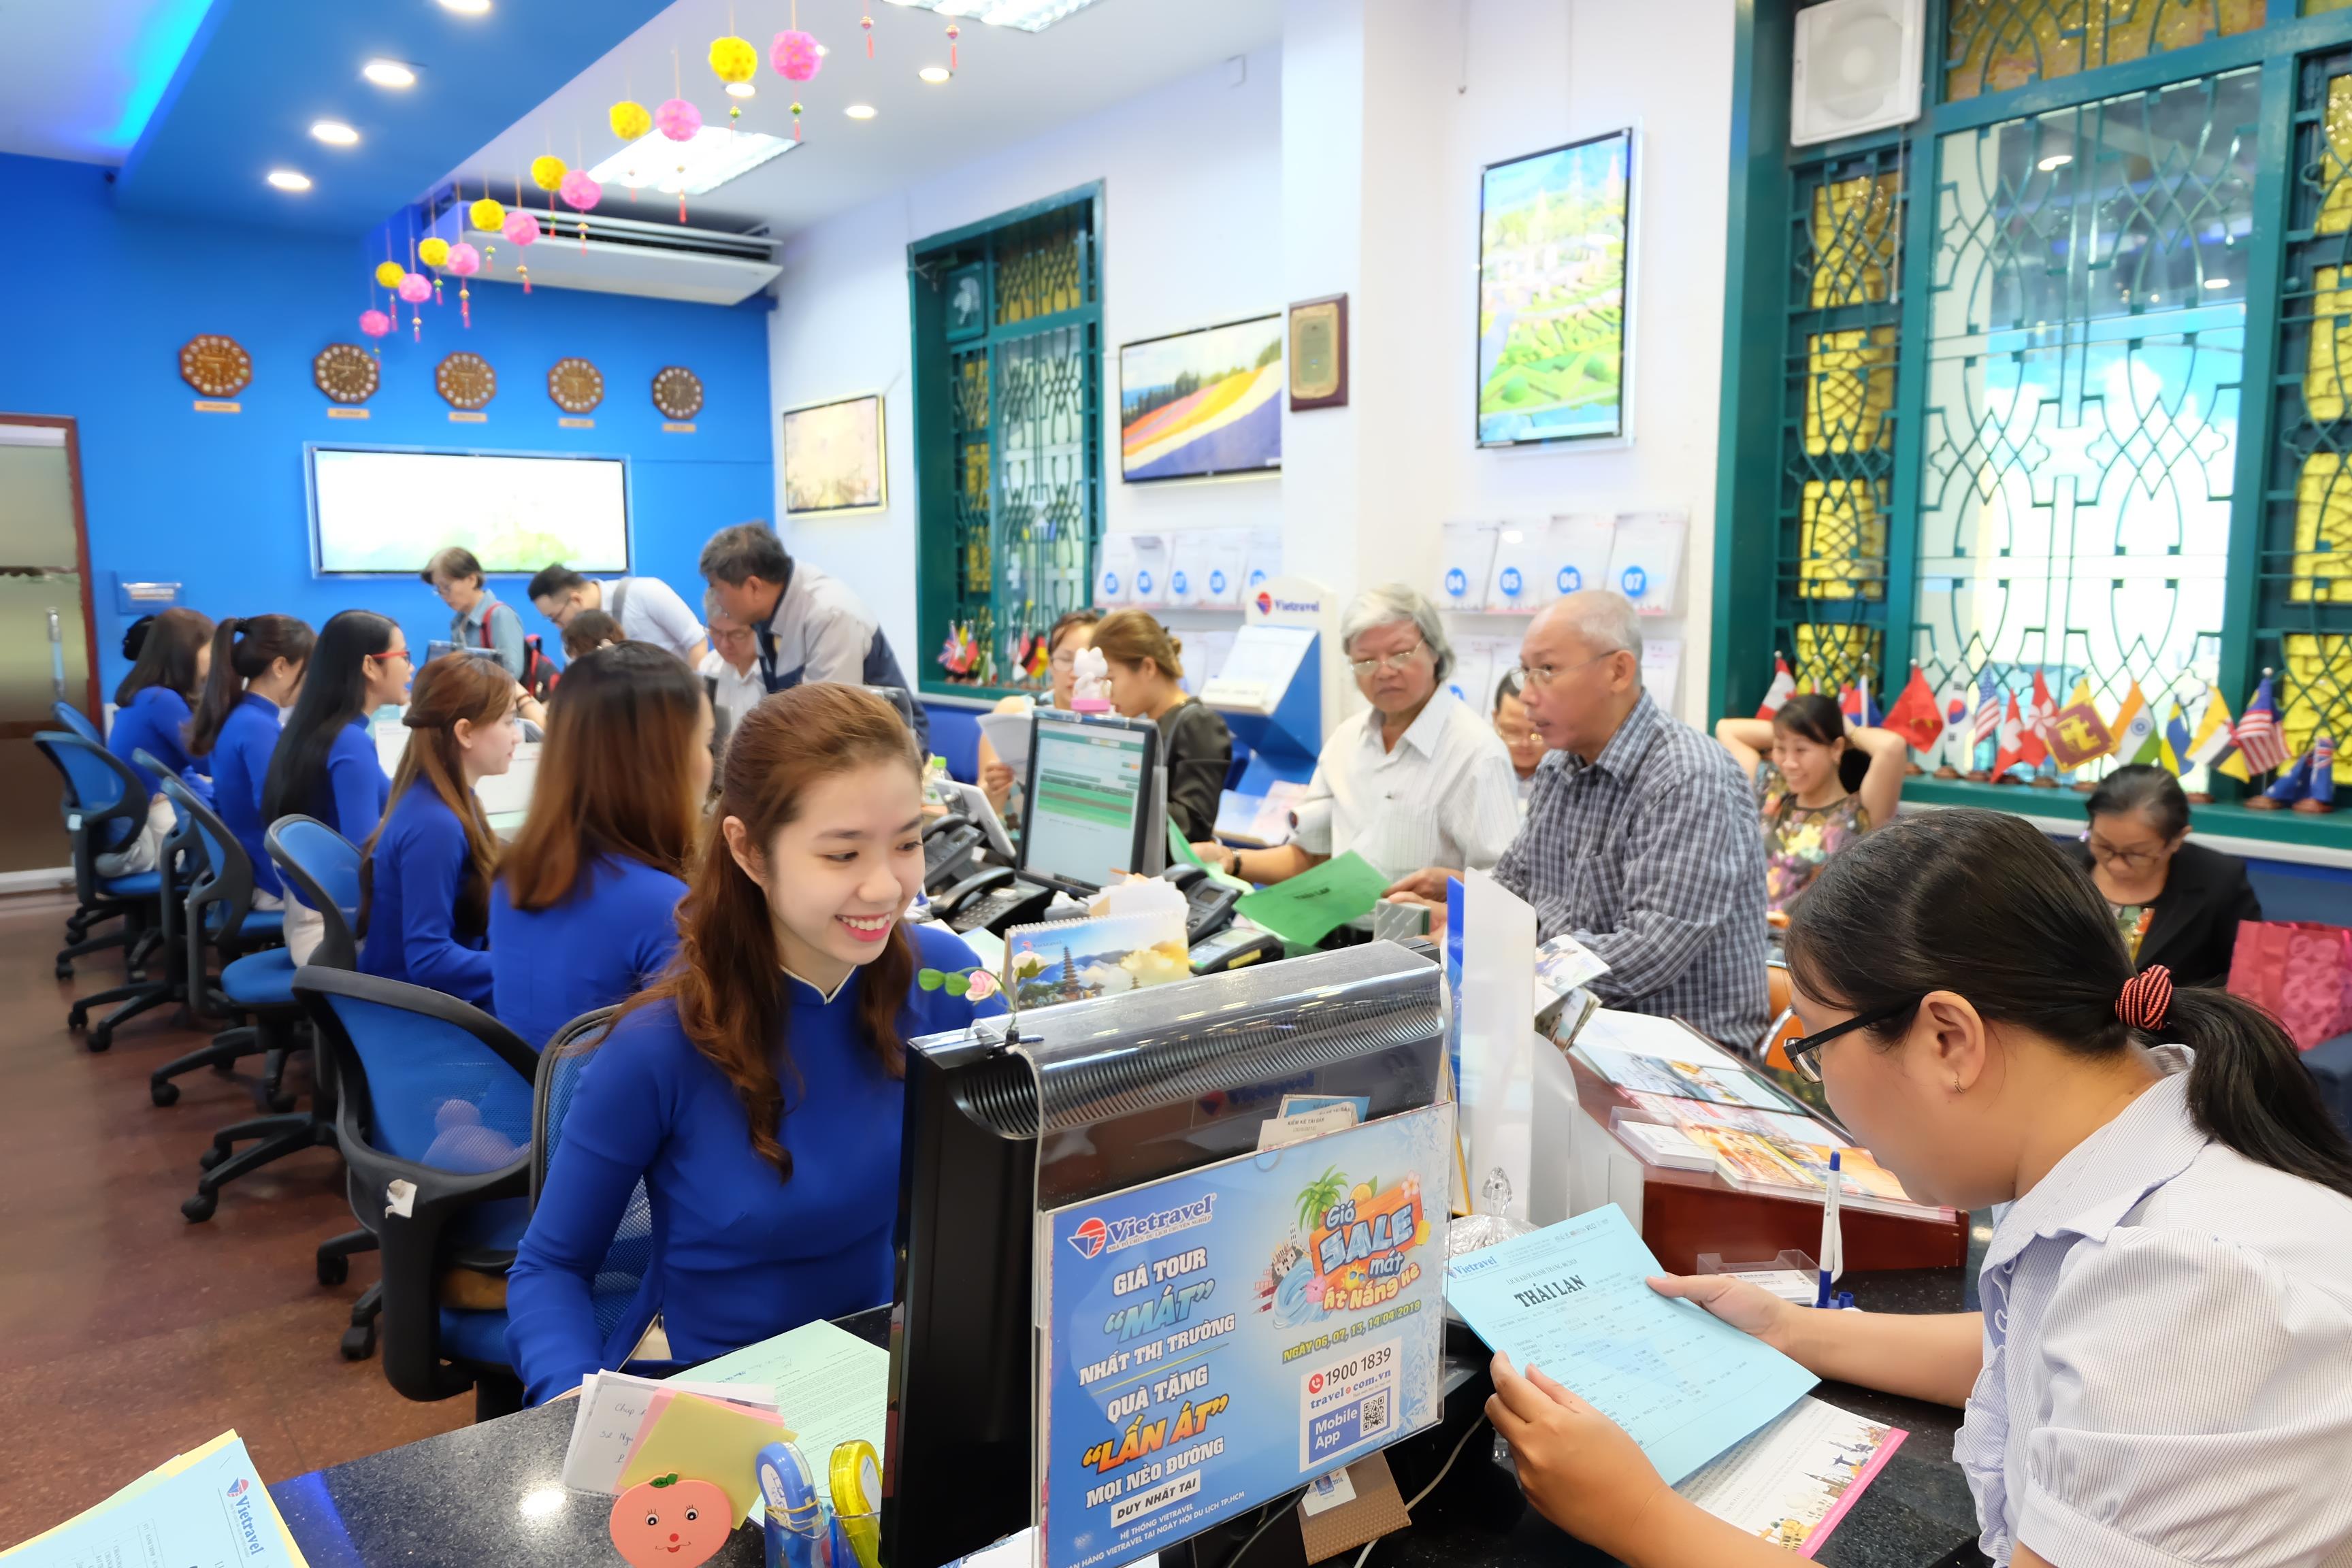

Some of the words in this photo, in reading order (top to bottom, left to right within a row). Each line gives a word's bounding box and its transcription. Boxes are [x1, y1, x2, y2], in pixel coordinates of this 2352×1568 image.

[1448, 575, 1463, 590] 04
[1502, 574, 1518, 589] 05
[1560, 572, 1578, 589] 06
[1624, 573, 1643, 590] 07
[1275, 600, 1320, 612] Vietravel
[1108, 1194, 1212, 1242] Vietravel
[1326, 1200, 1356, 1228] Gió
[1319, 1203, 1414, 1275] SALE
[1113, 1264, 1149, 1296] GIÁ
[1153, 1247, 1207, 1283] TOUR
[1369, 1250, 1405, 1275] mát
[1454, 1256, 1497, 1275] Vietravel
[1324, 1286, 1348, 1311] Át
[1349, 1277, 1399, 1310] Nắng
[1401, 1262, 1420, 1287] Hè
[1514, 1283, 1558, 1307] THÁI
[1552, 1274, 1587, 1296] LAN
[1079, 1350, 1130, 1386] NHẤT
[1134, 1340, 1163, 1365] THỊ
[1167, 1313, 1235, 1353] TRƯỜNG
[1284, 1343, 1315, 1363] NGÀY
[1315, 1335, 1330, 1350] 06,
[1332, 1328, 1349, 1343] 07,
[1351, 1321, 1365, 1337] 13,
[1368, 1300, 1421, 1329] 14/04/2018
[1325, 1361, 1358, 1386] 1900
[1361, 1348, 1392, 1372] 1839
[1107, 1385, 1149, 1424] QUÀ
[1154, 1363, 1209, 1403] TẶNG
[1315, 1407, 1358, 1435] Mobile
[1315, 1430, 1341, 1450] App
[1086, 1478, 1123, 1509] MỌI
[1126, 1463, 1162, 1491] NẺO
[1166, 1437, 1224, 1475] ĐƯỜNG
[1117, 1503, 1141, 1519] DUY
[1145, 1485, 1175, 1507] NHẤT
[1179, 1478, 1197, 1492] TẠI
[236, 1494, 265, 1556] Vietravel
[1081, 1552, 1105, 1567] HÀNG
[1106, 1535, 1143, 1556] VIETRAVEL
[1145, 1529, 1156, 1539] TẠI
[1157, 1520, 1177, 1535] NGÀY
[1179, 1512, 1192, 1525] HỘI
[1194, 1510, 1203, 1519] DU
[1205, 1503, 1220, 1514] LỊCH
[1221, 1491, 1245, 1507] TP.HCM
[1120, 1531, 1130, 1540] HỆ
[1132, 1519, 1157, 1535] THỐNG
[1160, 1503, 1193, 1522] VIETRAVEL
